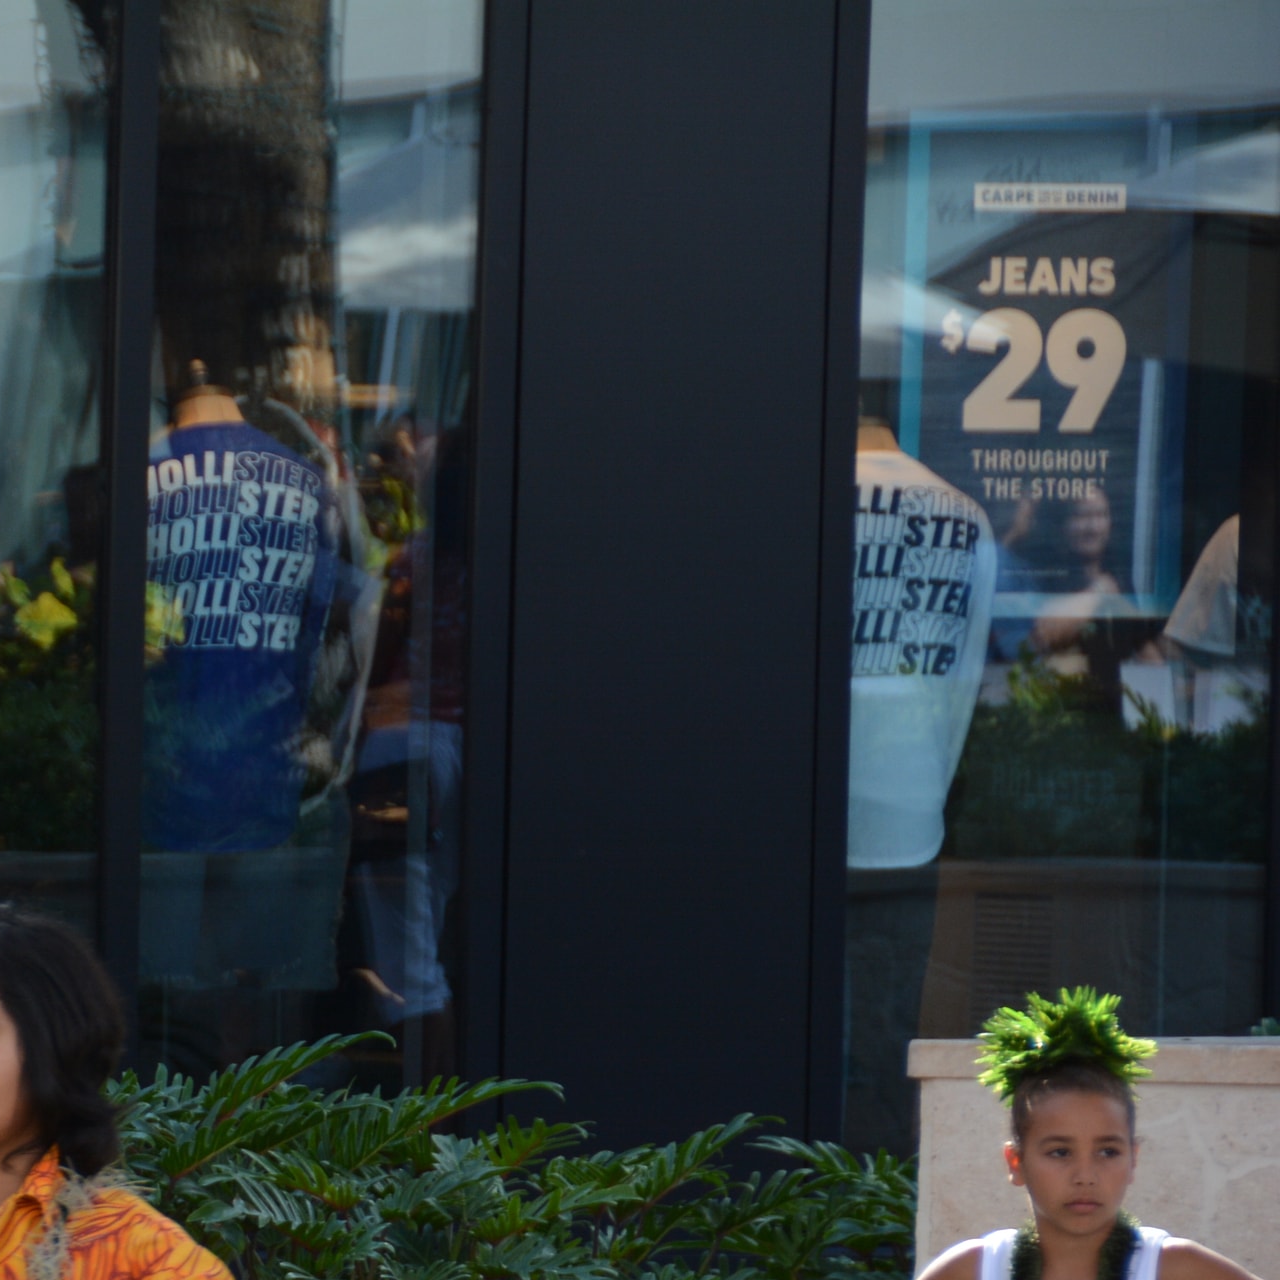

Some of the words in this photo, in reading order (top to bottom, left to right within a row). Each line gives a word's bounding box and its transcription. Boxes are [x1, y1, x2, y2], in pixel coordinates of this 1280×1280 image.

[981, 189, 1035, 204] CARPE
[1065, 189, 1120, 204] DENIM
[978, 256, 1117, 297] JEANS
[942, 306, 1127, 432] $29
[971, 449, 1109, 471] THROUGHOUT
[982, 477, 1022, 499] THE
